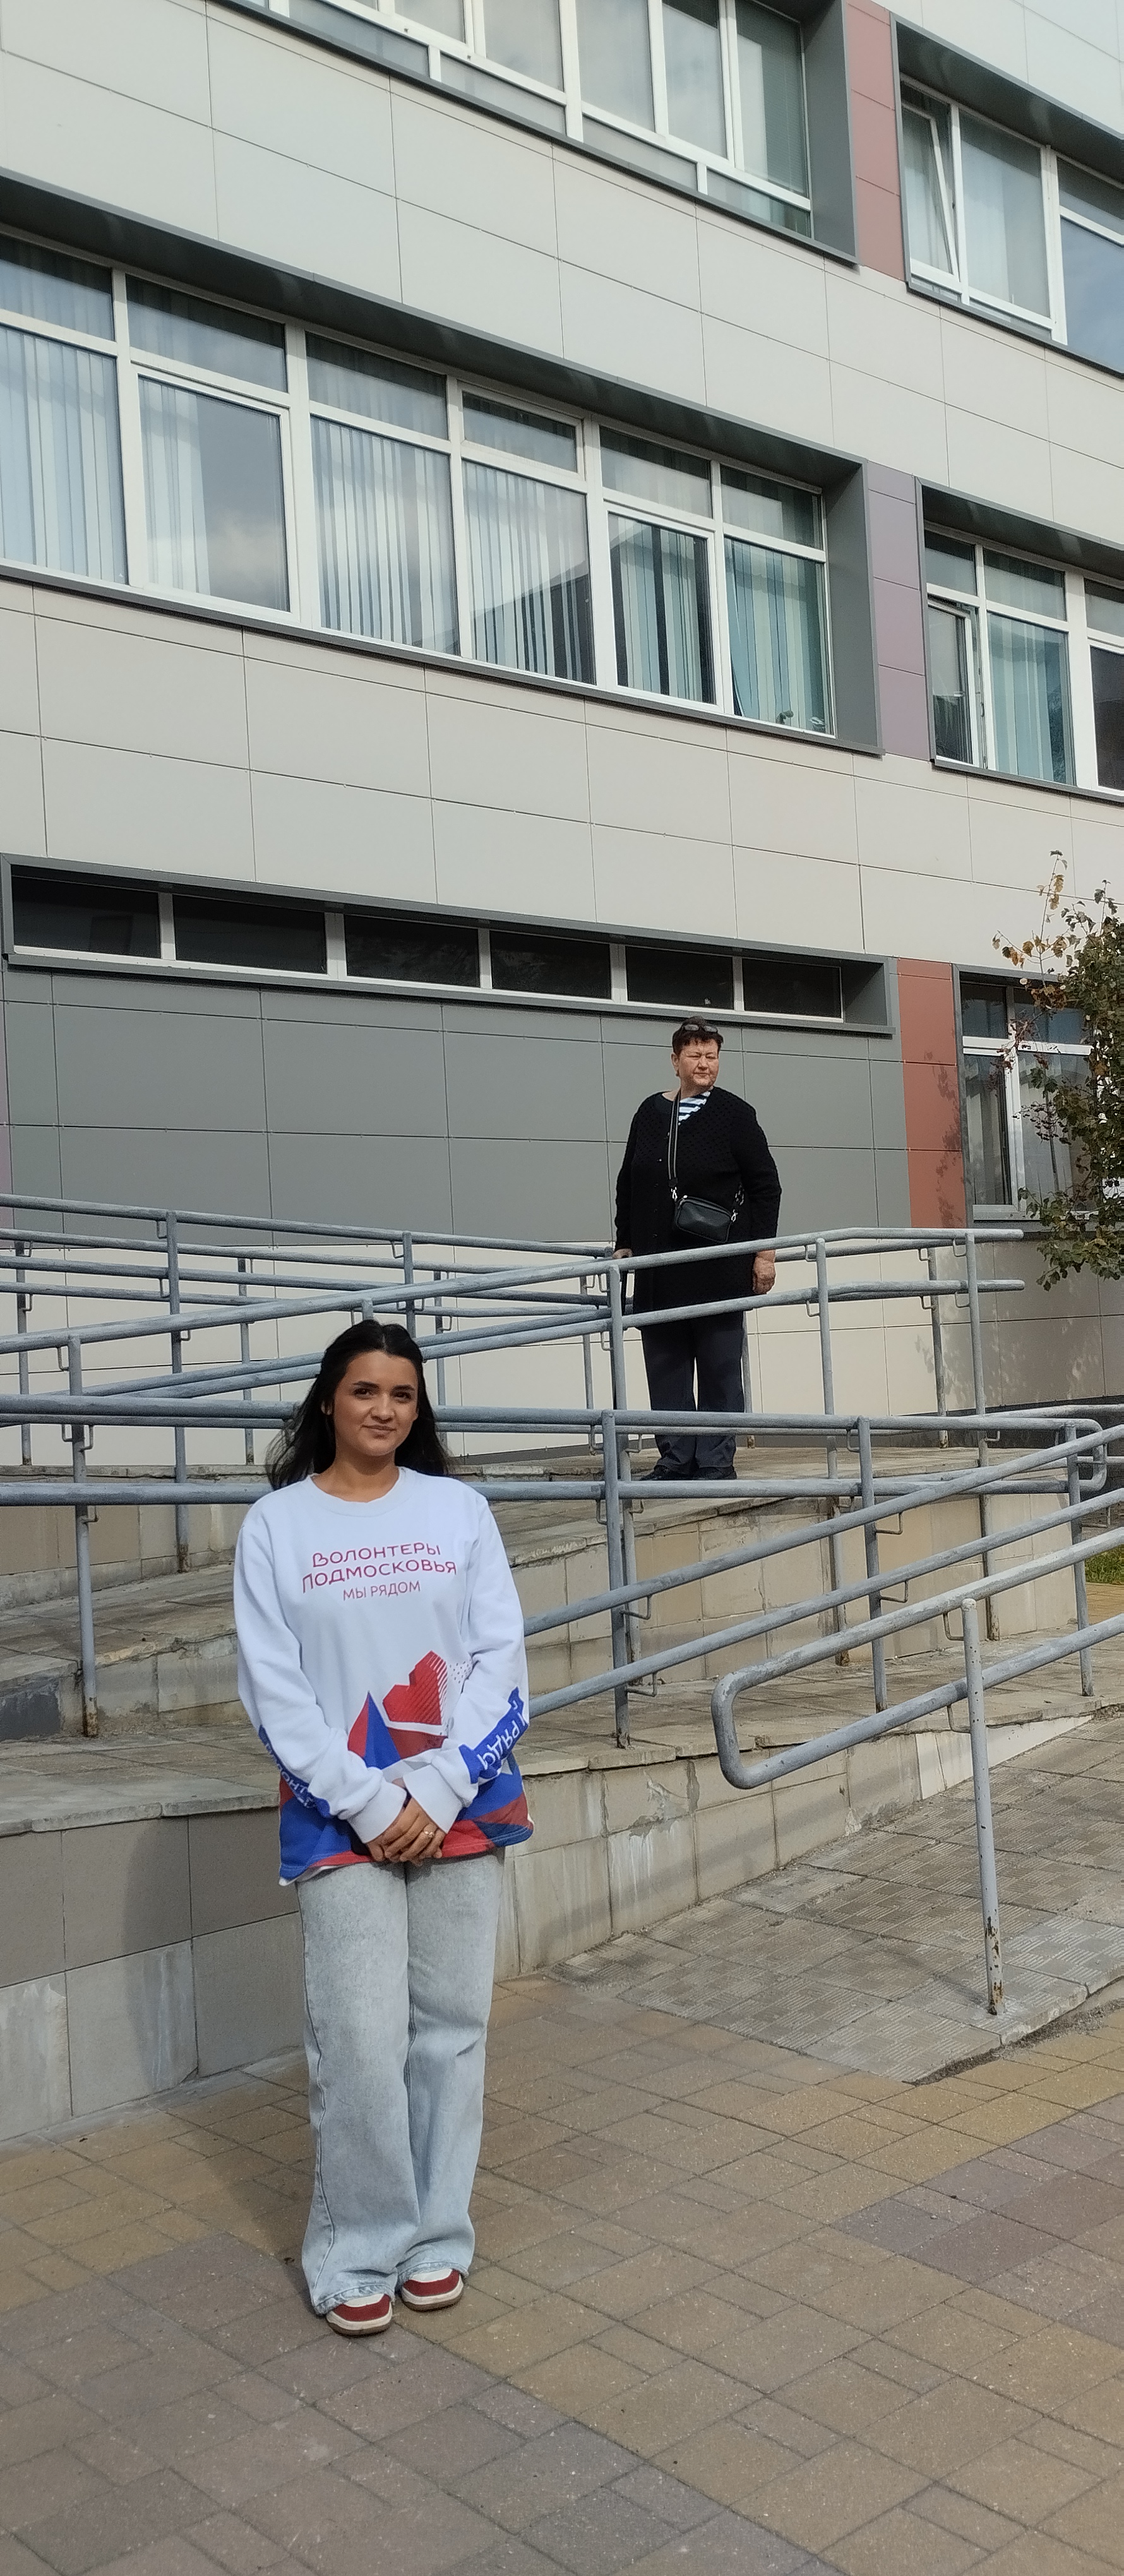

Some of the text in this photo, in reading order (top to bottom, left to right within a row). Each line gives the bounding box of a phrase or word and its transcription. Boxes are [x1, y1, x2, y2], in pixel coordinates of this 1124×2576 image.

[313, 1542, 441, 1567] ВОЛОНТЕРЫ
[302, 1559, 457, 1594] ПОДМОСКОВЬЯ
[344, 1580, 421, 1601] МЫ РЯДОМ
